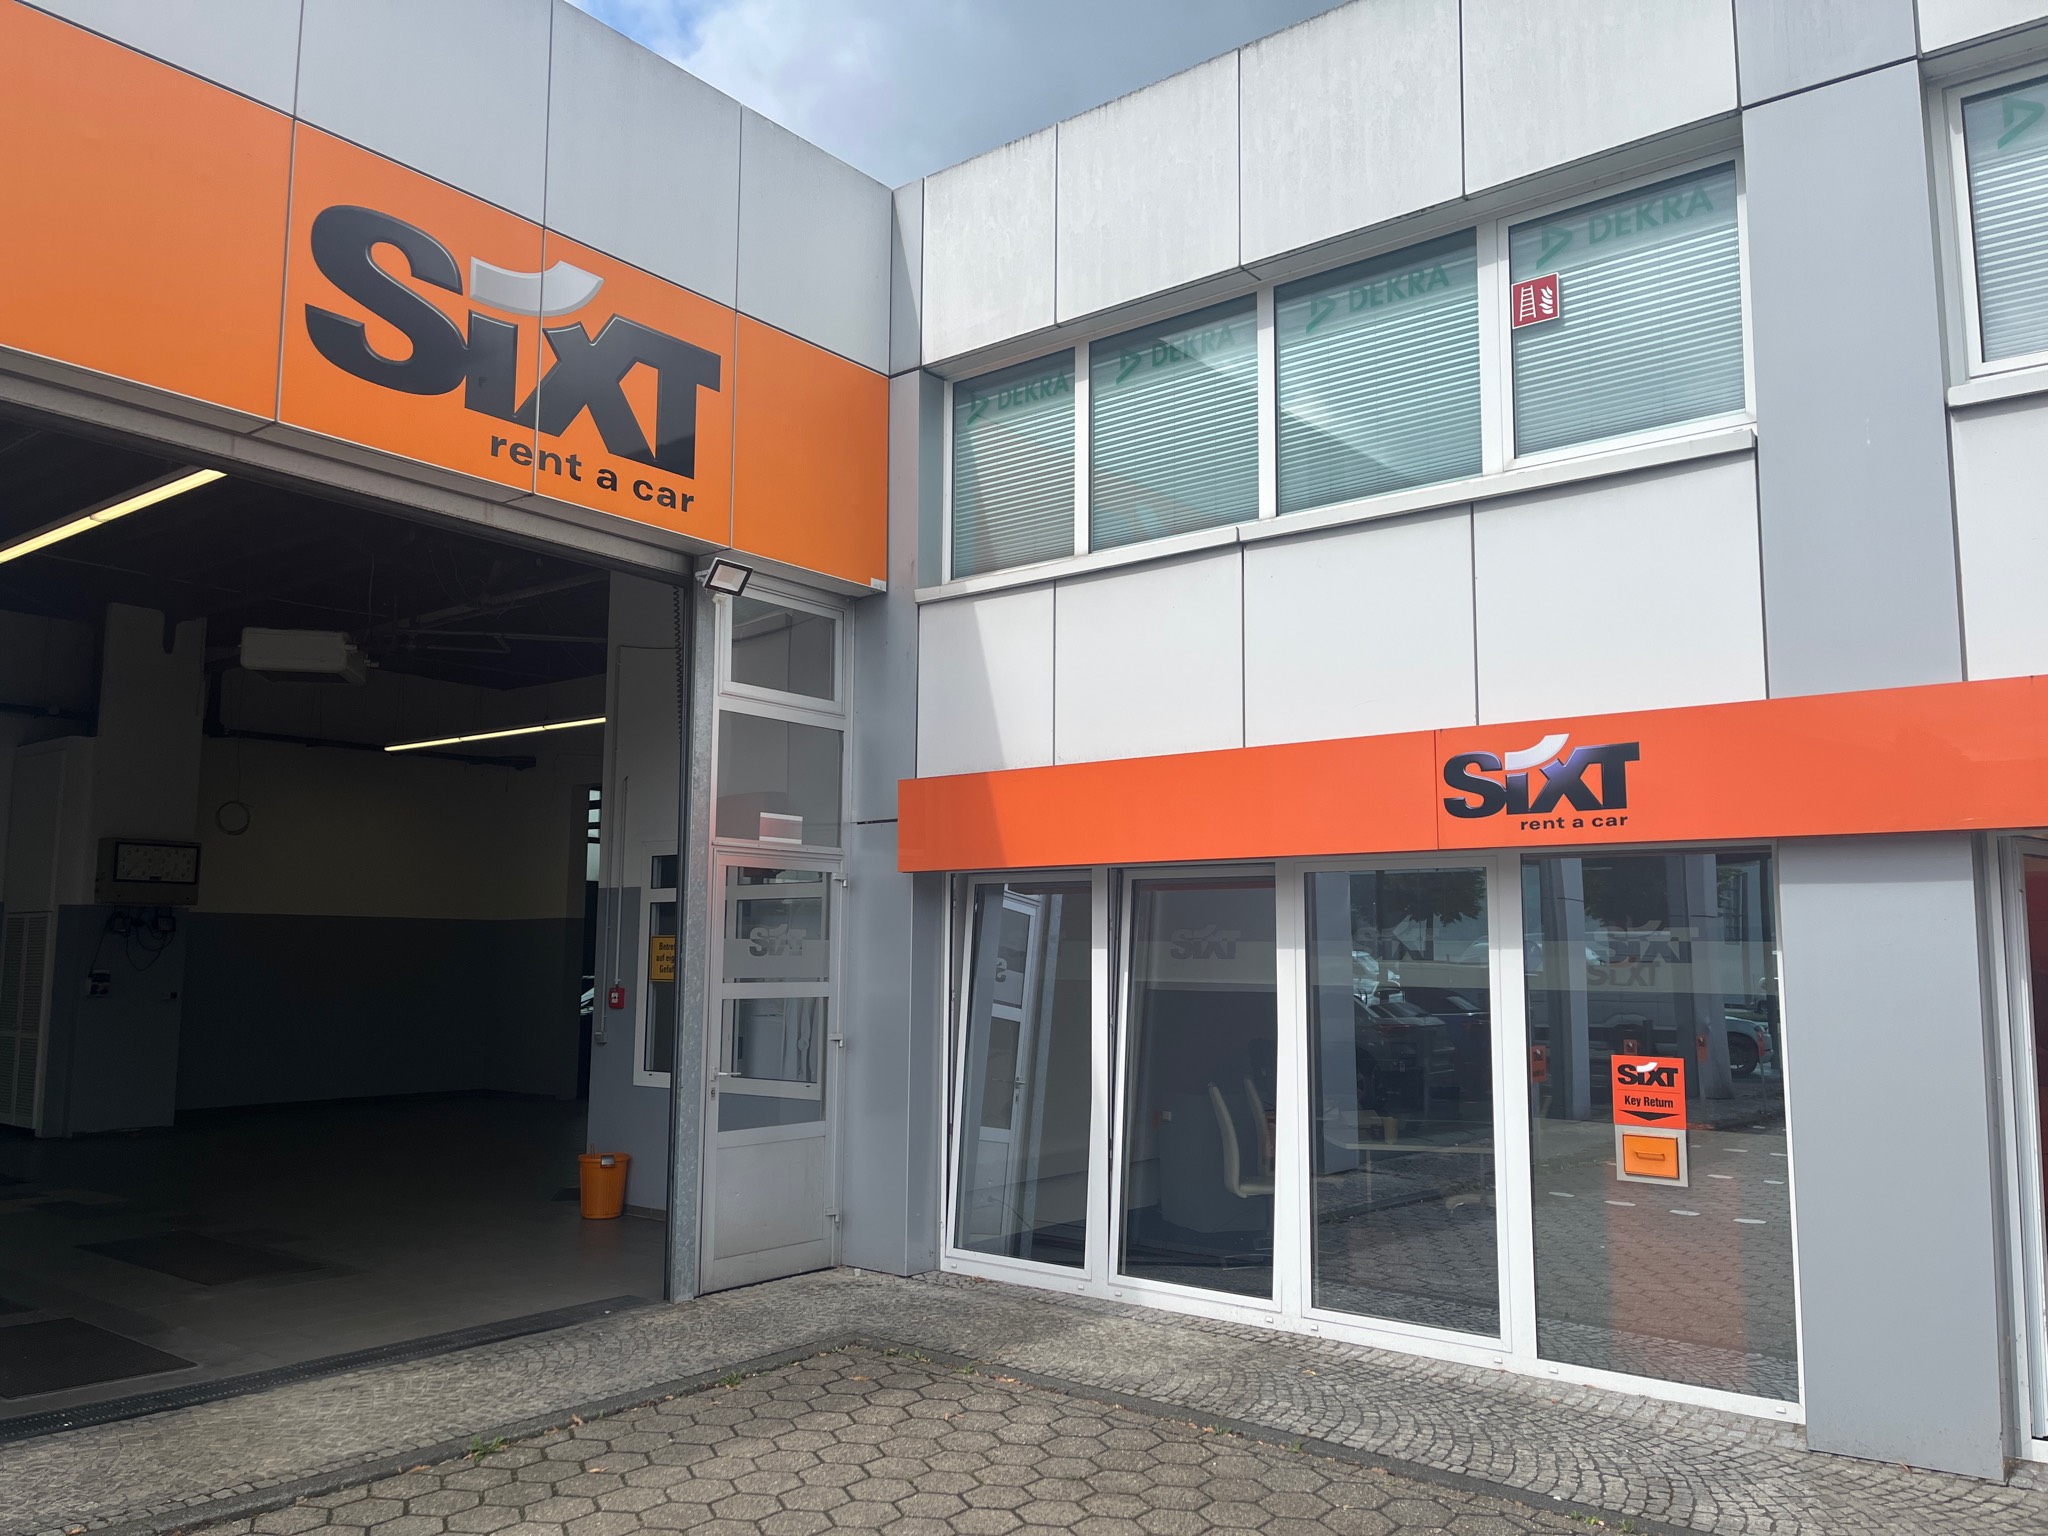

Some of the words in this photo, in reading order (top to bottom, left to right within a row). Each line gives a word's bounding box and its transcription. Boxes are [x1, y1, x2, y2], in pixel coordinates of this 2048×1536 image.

[1588, 184, 1714, 246] DEKRA
[1348, 262, 1450, 314] DEKRA
[304, 204, 721, 479] SIXT
[1151, 323, 1235, 368] DEKRA
[997, 370, 1070, 411] DEKRA
[490, 435, 583, 483] rent
[596, 464, 619, 491] a
[632, 478, 696, 513] car
[1443, 733, 1640, 818] SIXT
[1520, 816, 1565, 831] rent
[1572, 818, 1584, 828] a
[1592, 815, 1629, 827] car
[1617, 1062, 1678, 1088] SIXT
[1624, 1095, 1641, 1108] Key
[1643, 1096, 1674, 1108] Return
